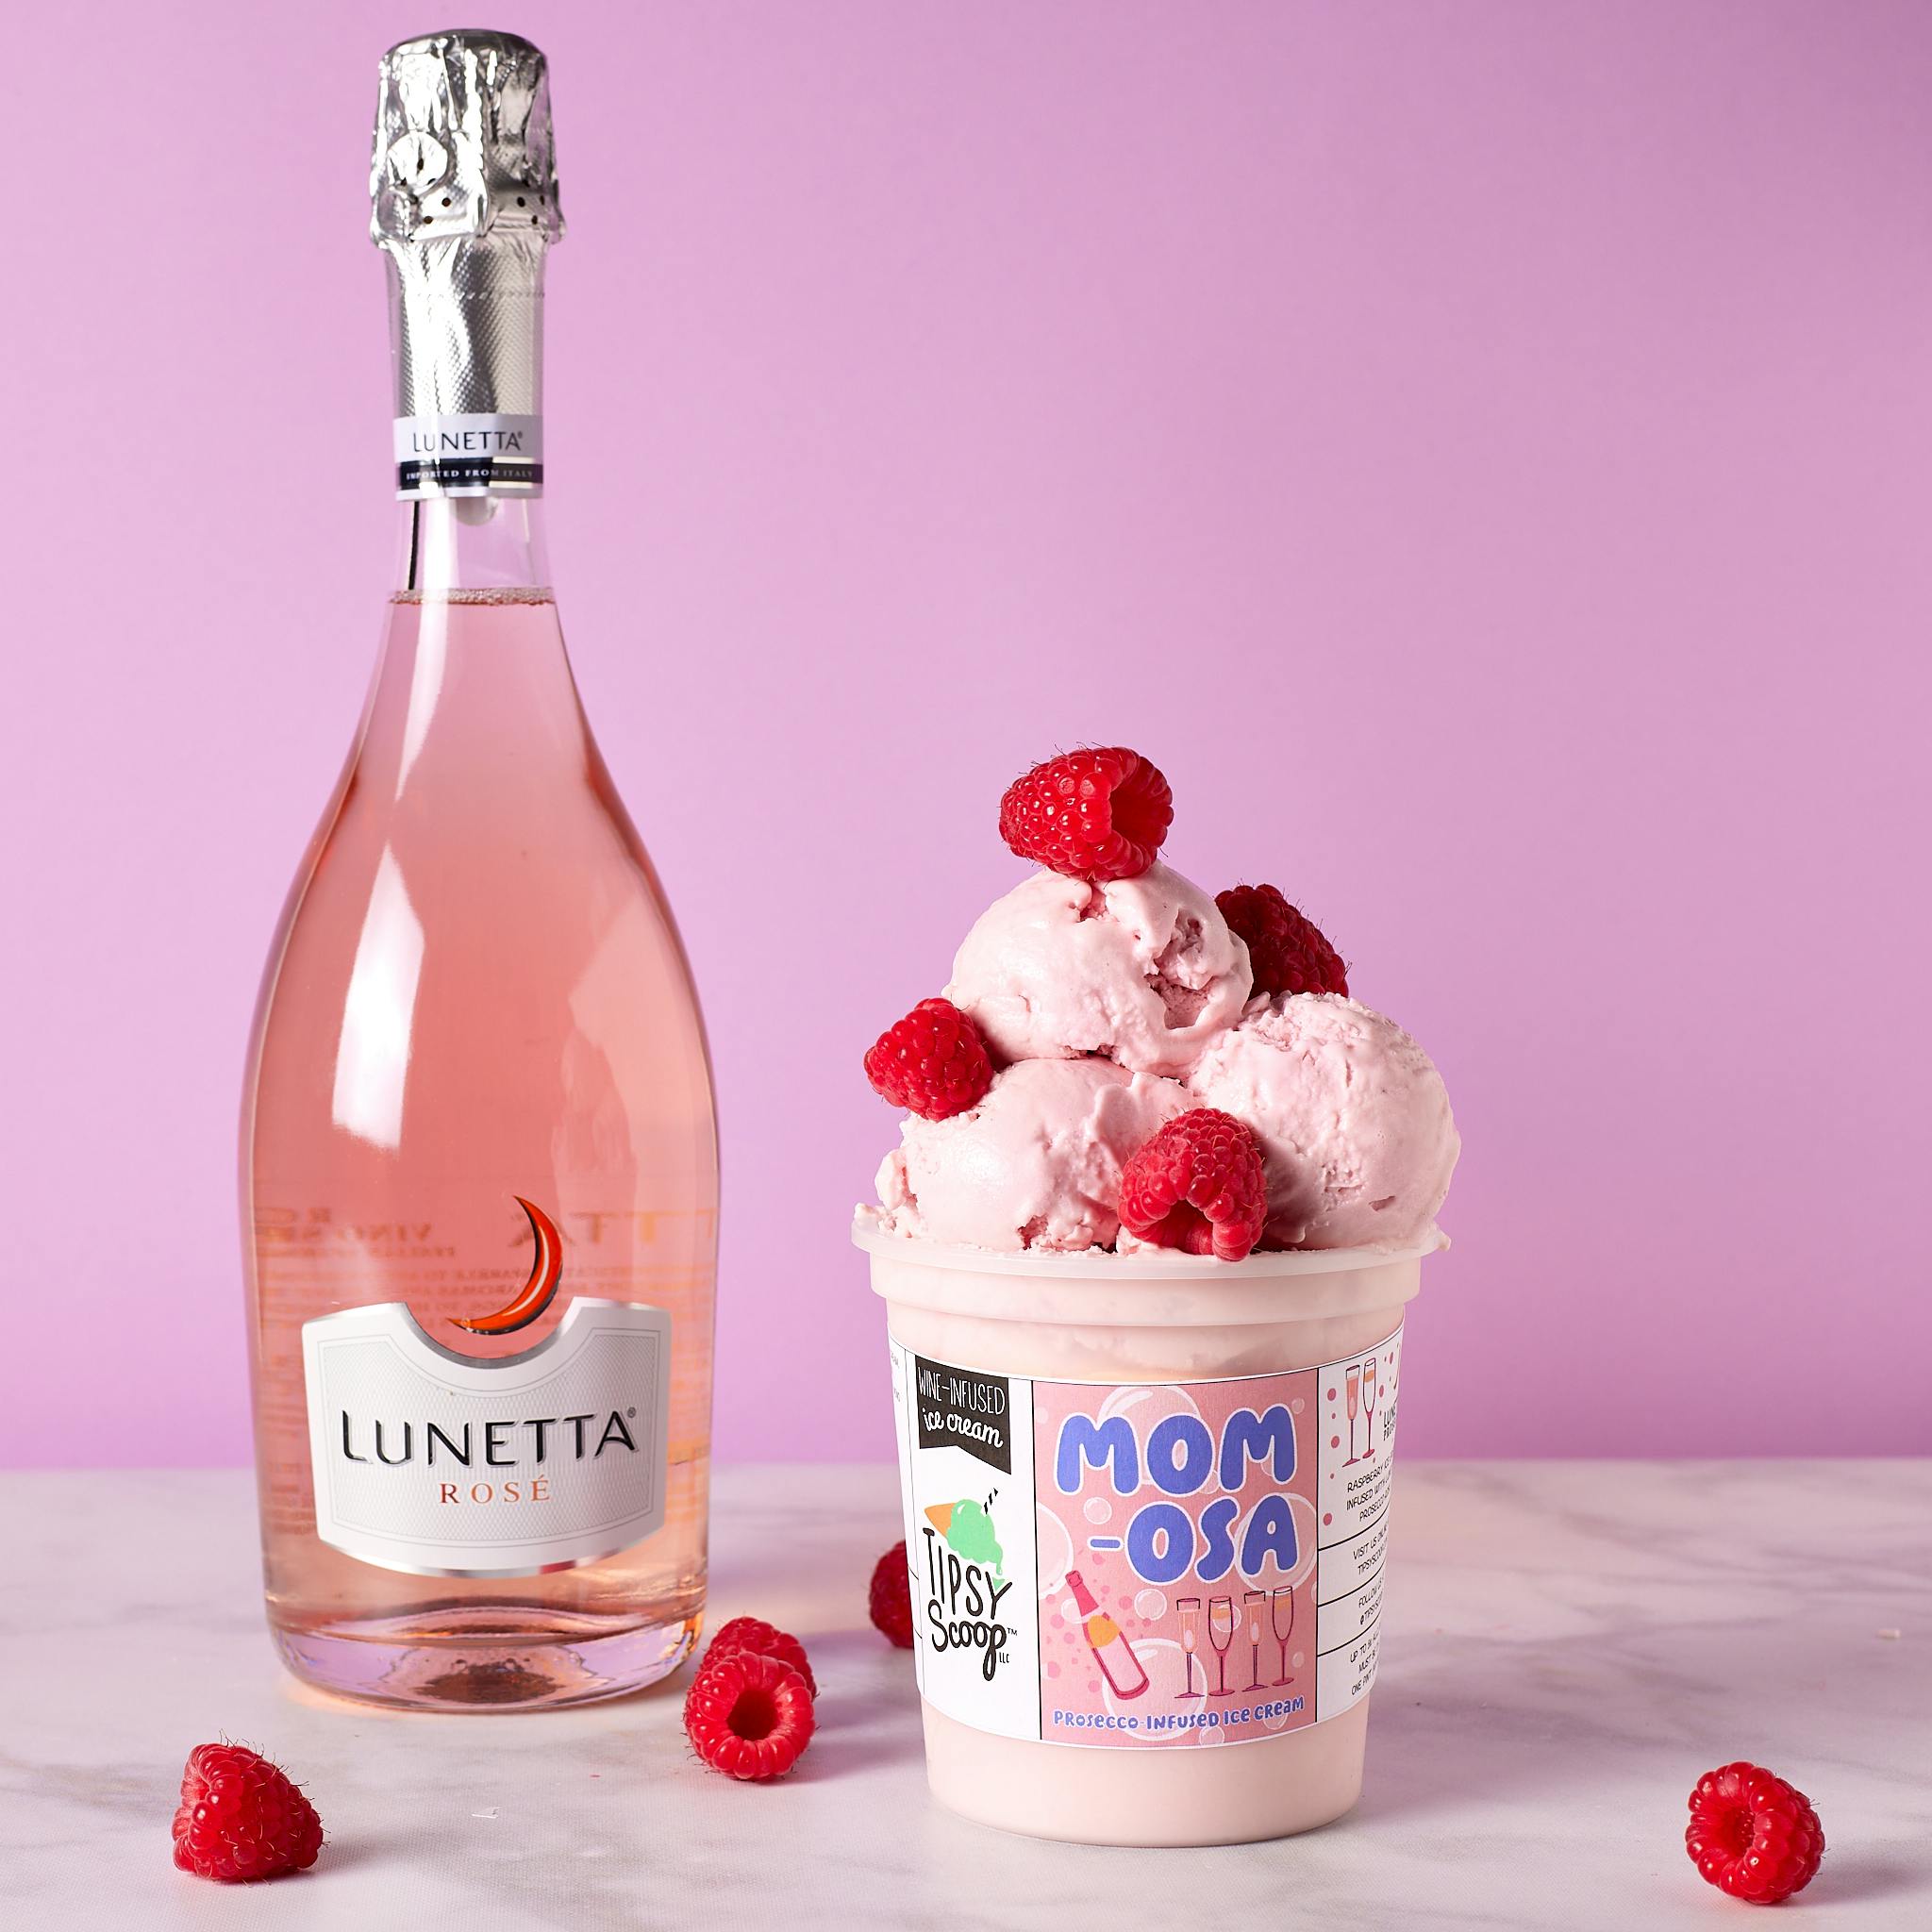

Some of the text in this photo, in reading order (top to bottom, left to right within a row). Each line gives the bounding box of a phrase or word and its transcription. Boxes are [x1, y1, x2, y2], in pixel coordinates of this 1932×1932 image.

[465, 468, 498, 478] FROM
[504, 470, 533, 479] ITALY
[918, 1366, 1006, 1415] WINE-INFUSED
[922, 1407, 1004, 1448] ice cream
[1057, 1404, 1297, 1493] MOM
[440, 1474, 550, 1505] ROSÉ
[1347, 1463, 1384, 1492] RASPBERRY
[1346, 1489, 1374, 1511] INFUSED
[1353, 1542, 1370, 1559] VISIT
[923, 1527, 1013, 1621] TIPSY
[1358, 1588, 1377, 1607] FOLLOW
[927, 1599, 1008, 1681] Scoop
[1350, 1650, 1358, 1663] UP
[1351, 1680, 1362, 1695] ONE
[1224, 1708, 1251, 1725] ICE
[1254, 1695, 1305, 1722] CREAM
